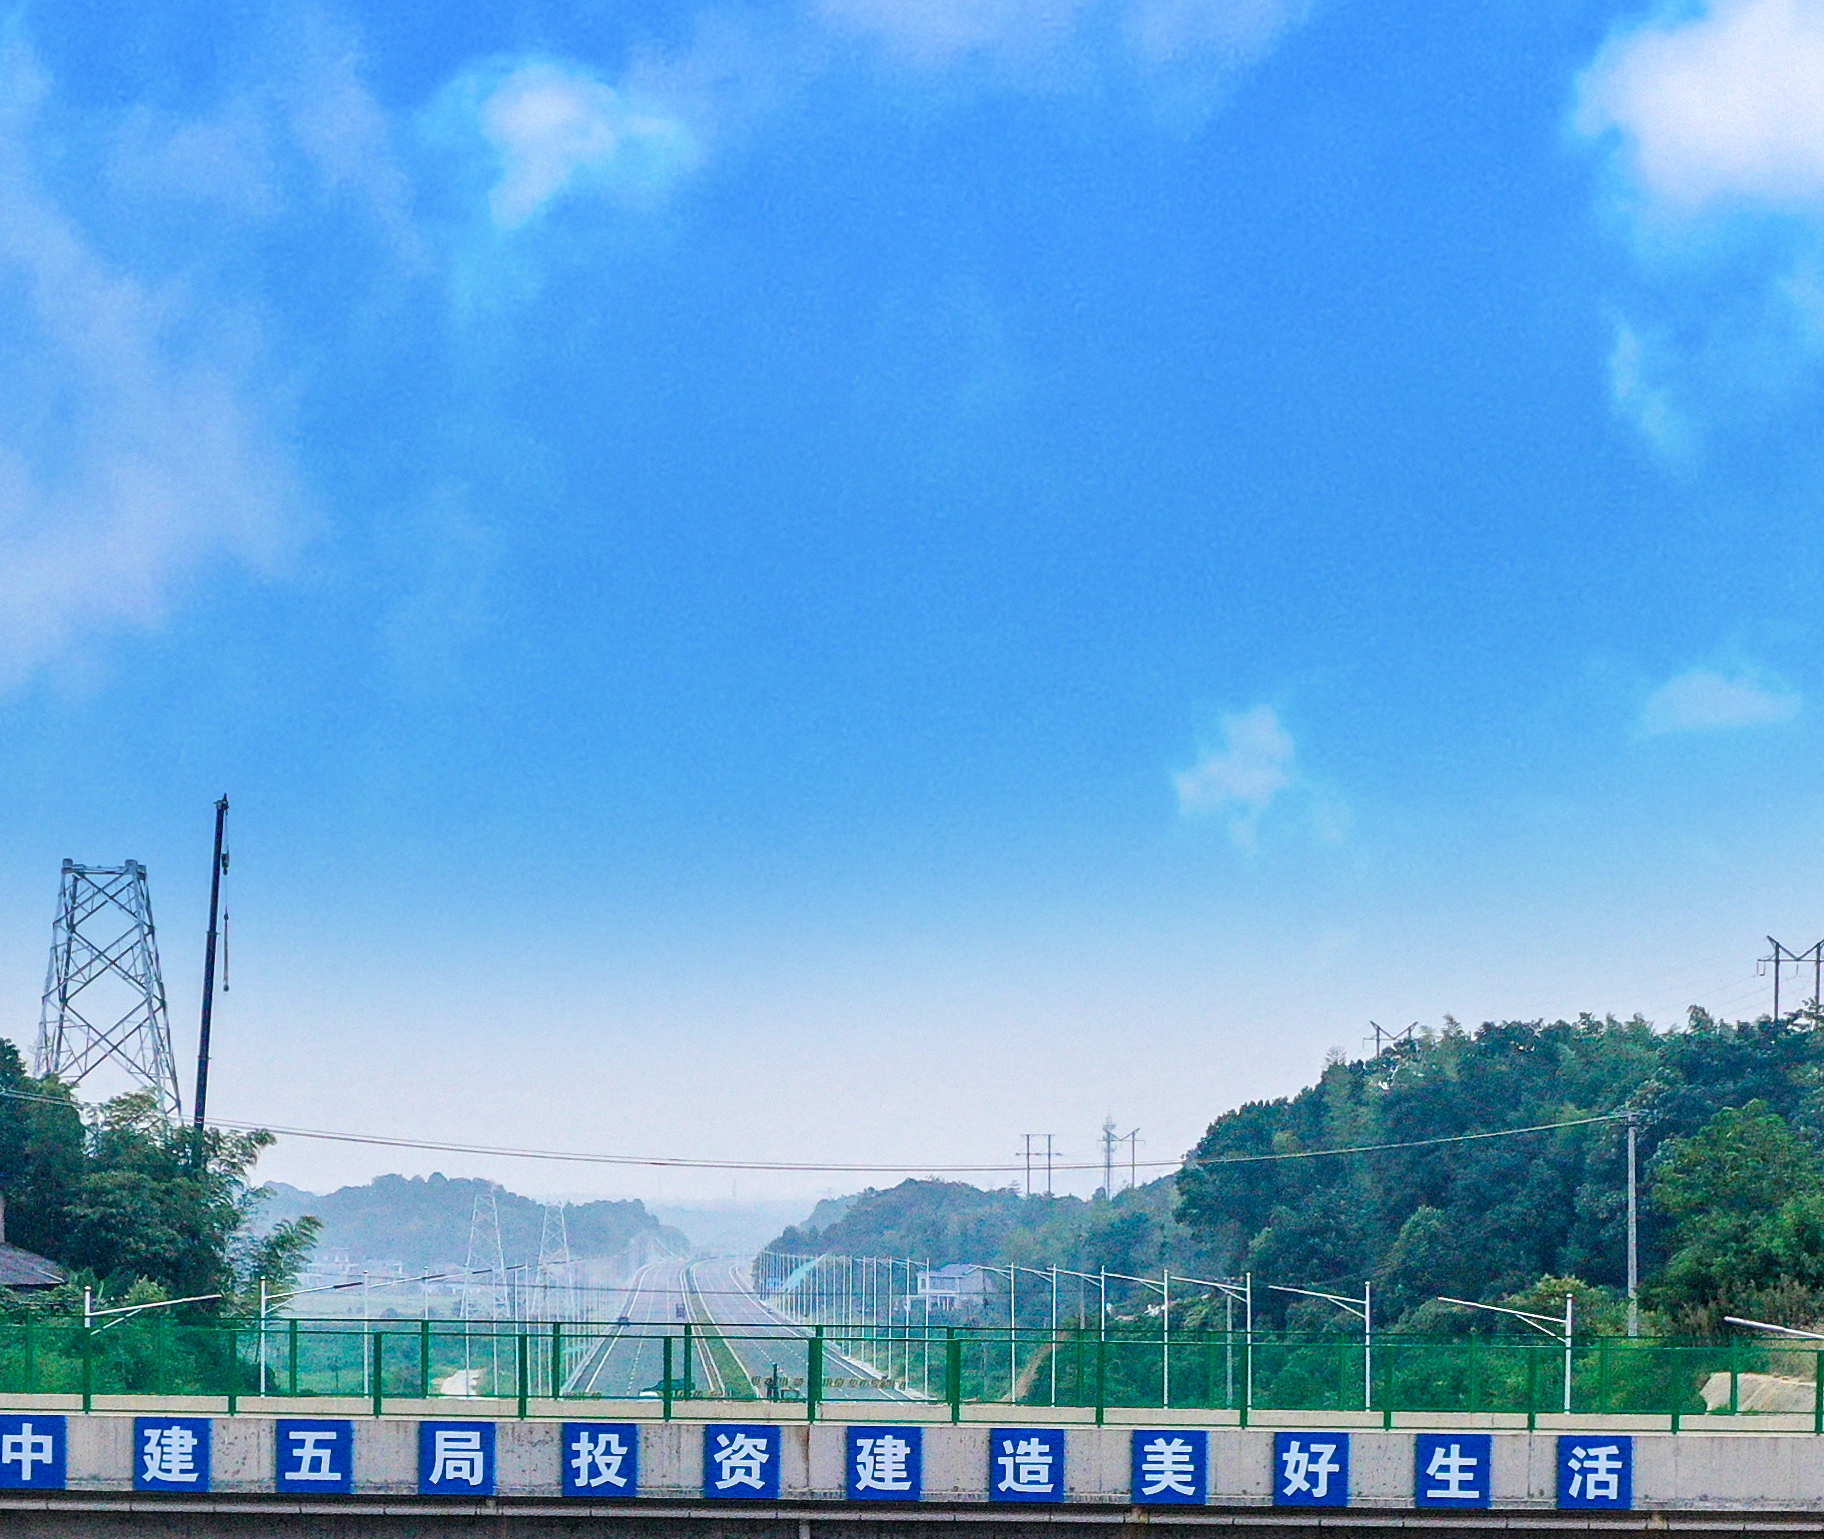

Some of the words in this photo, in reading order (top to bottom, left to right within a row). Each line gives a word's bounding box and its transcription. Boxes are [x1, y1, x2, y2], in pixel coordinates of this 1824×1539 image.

[2, 1422, 1623, 1500] 中建五局投资建造美好生活
